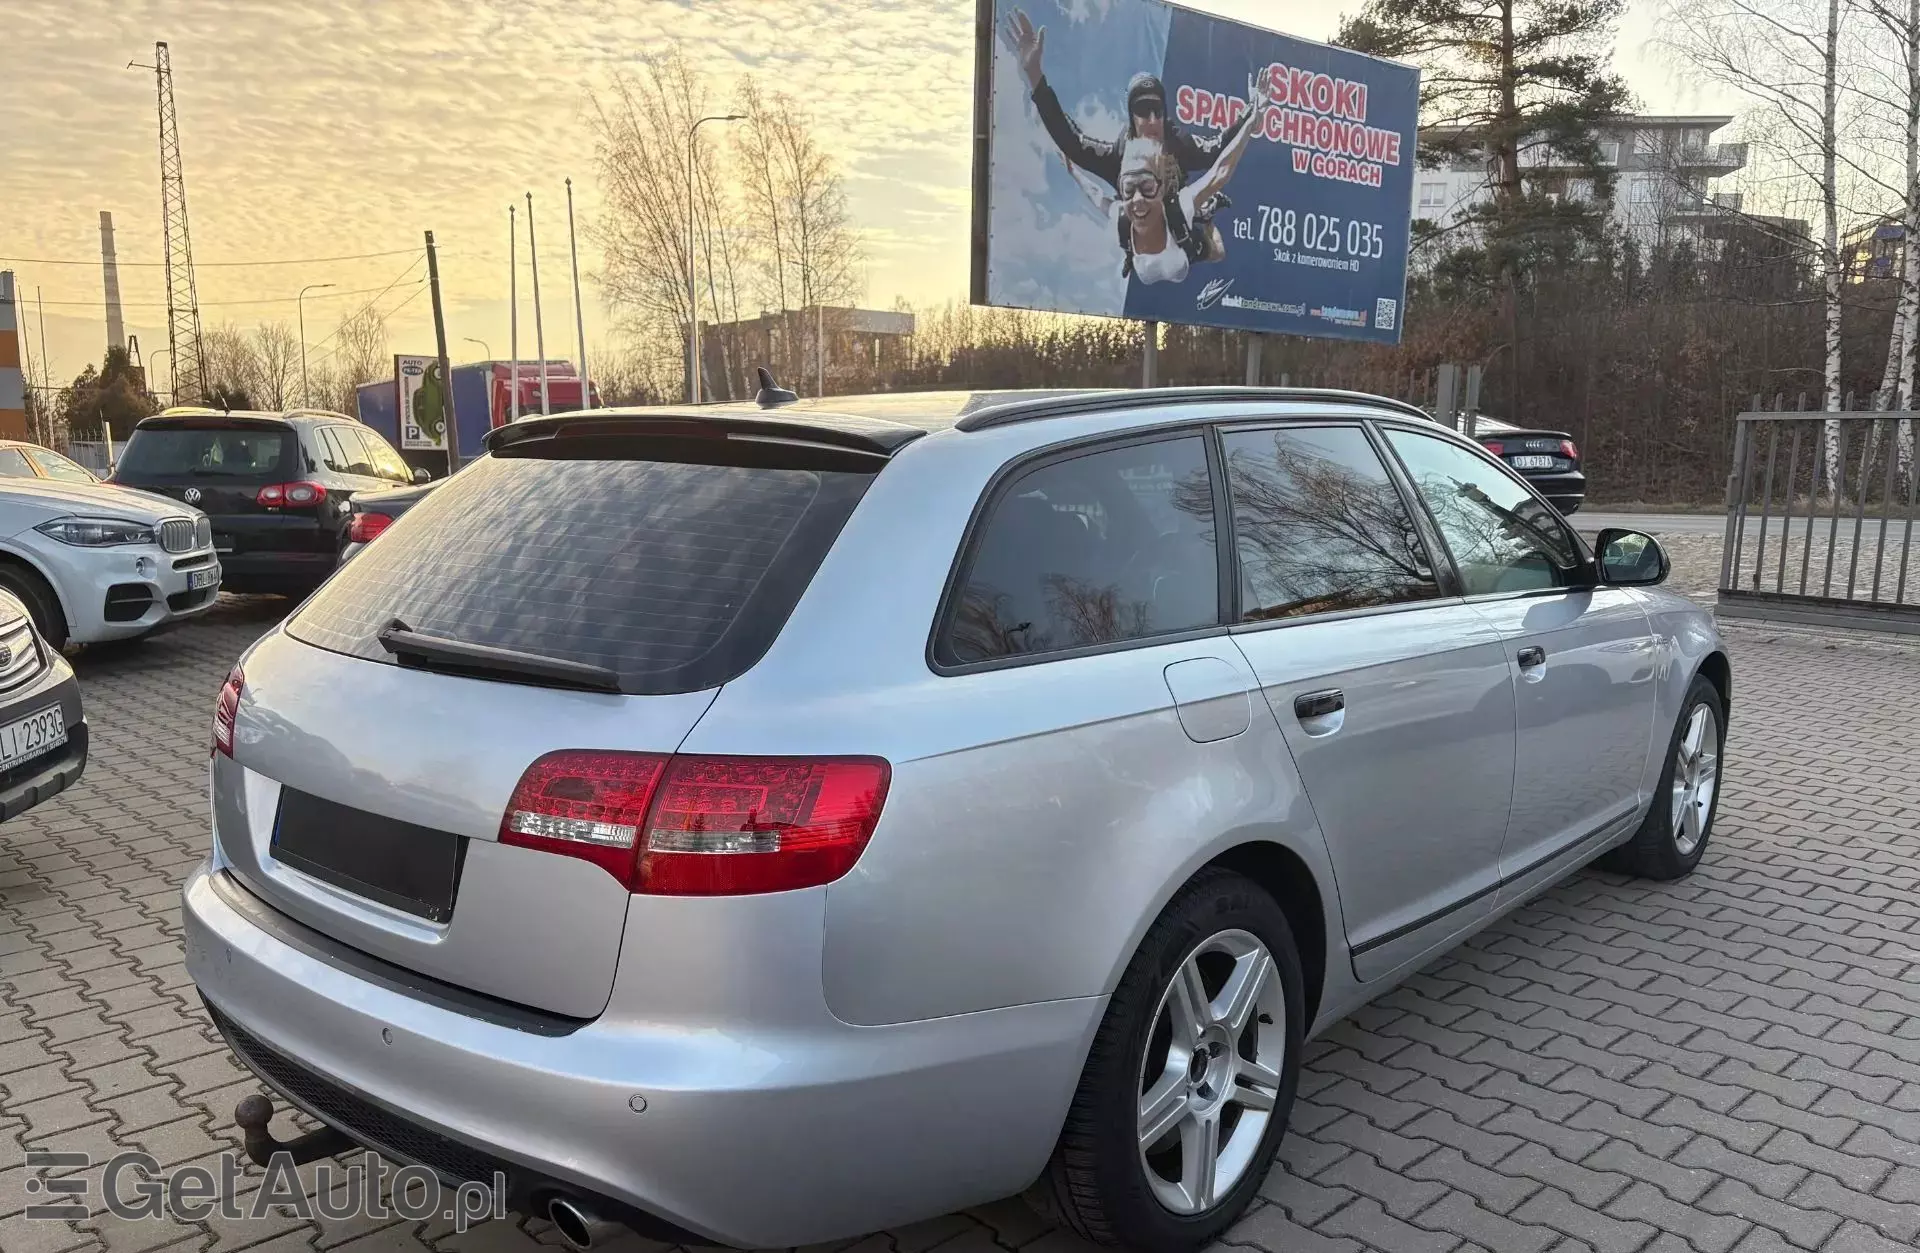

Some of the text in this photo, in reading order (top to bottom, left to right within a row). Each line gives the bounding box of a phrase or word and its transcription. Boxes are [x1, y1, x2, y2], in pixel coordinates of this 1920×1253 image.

[1269, 63, 1367, 122] SKOKI
[1176, 85, 1400, 165] SPADCHRONOWE
[1292, 149, 1382, 187] W GÓRACH
[1233, 205, 1383, 259] tel. 788 025 035
[1274, 248, 1290, 263] Skok
[1291, 254, 1296, 264] z
[1349, 259, 1360, 272] HD
[0, 708, 63, 762] LI 2393G
